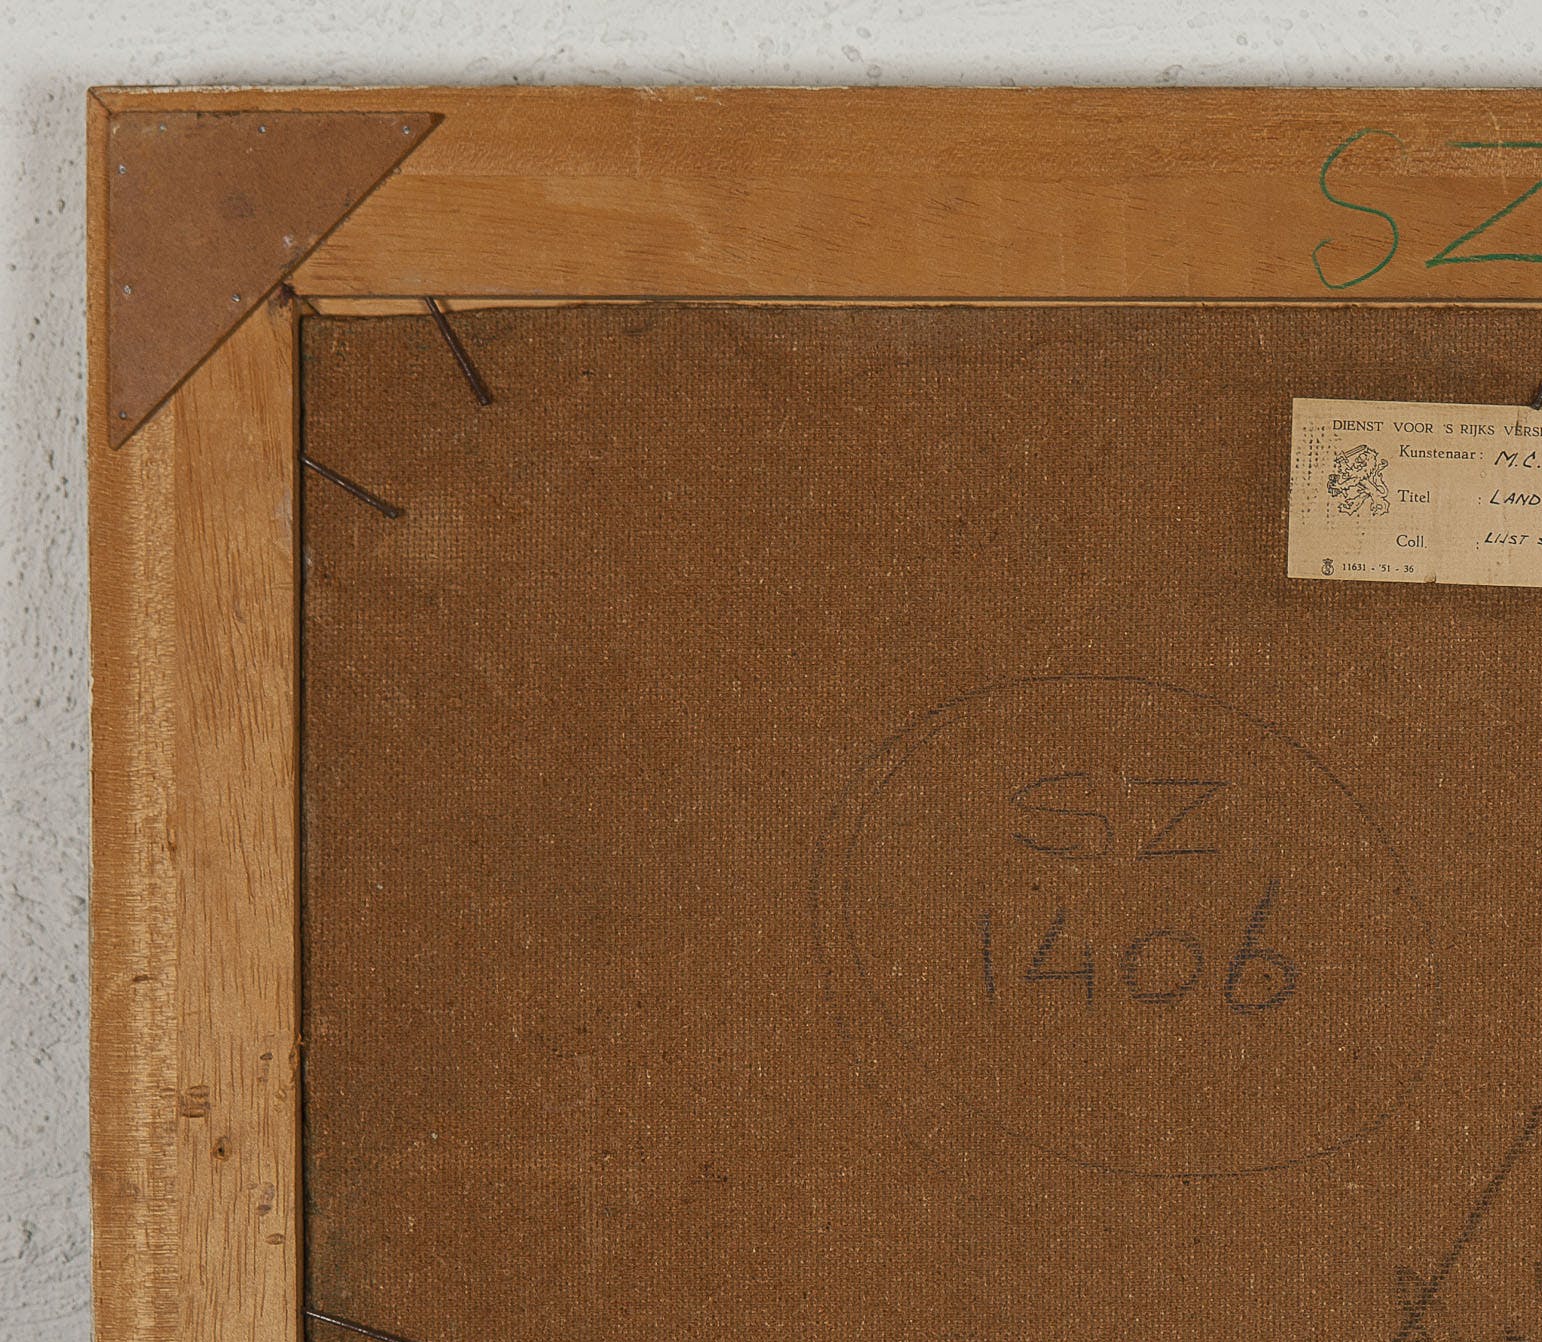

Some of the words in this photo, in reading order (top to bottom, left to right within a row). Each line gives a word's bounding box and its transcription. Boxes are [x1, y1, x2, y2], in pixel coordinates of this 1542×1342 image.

[1333, 419, 1383, 432] DIENST
[1393, 421, 1434, 434] VOOR
[1460, 424, 1495, 437] RIJKS
[1397, 489, 1431, 503] Titel
[1396, 534, 1427, 549] Coll.
[1342, 563, 1366, 571] 11631
[1404, 565, 1414, 573] 36
[1009, 771, 1230, 860] SZ
[982, 878, 1297, 1016] 1406
